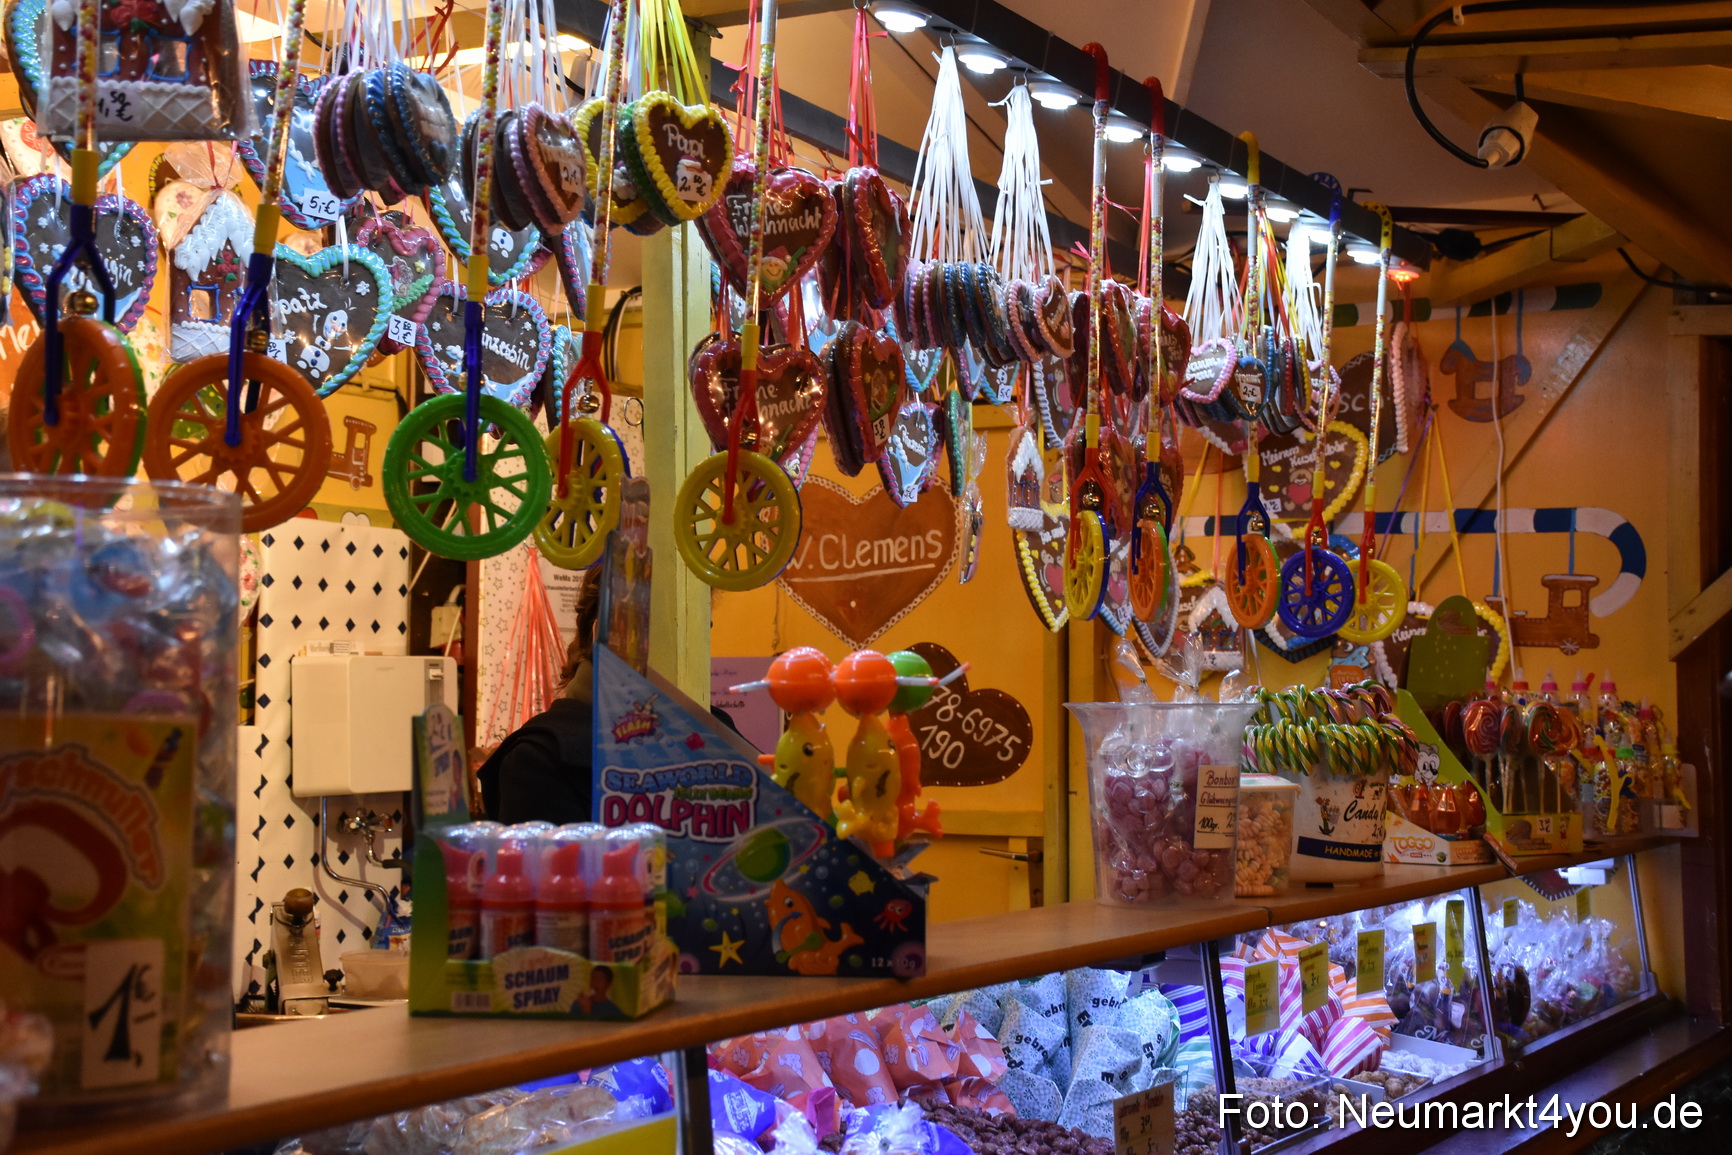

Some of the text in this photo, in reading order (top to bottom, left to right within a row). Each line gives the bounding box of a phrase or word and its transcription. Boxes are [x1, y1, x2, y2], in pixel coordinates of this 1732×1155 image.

[662, 122, 707, 159] Papi
[604, 763, 754, 794] SEAWORLD
[603, 793, 750, 838] DOLPHIN
[1324, 845, 1374, 859] HANDMADE
[1389, 836, 1435, 852] TOGGO
[504, 963, 570, 990] SCHAUM
[513, 986, 561, 1010] SPRAY
